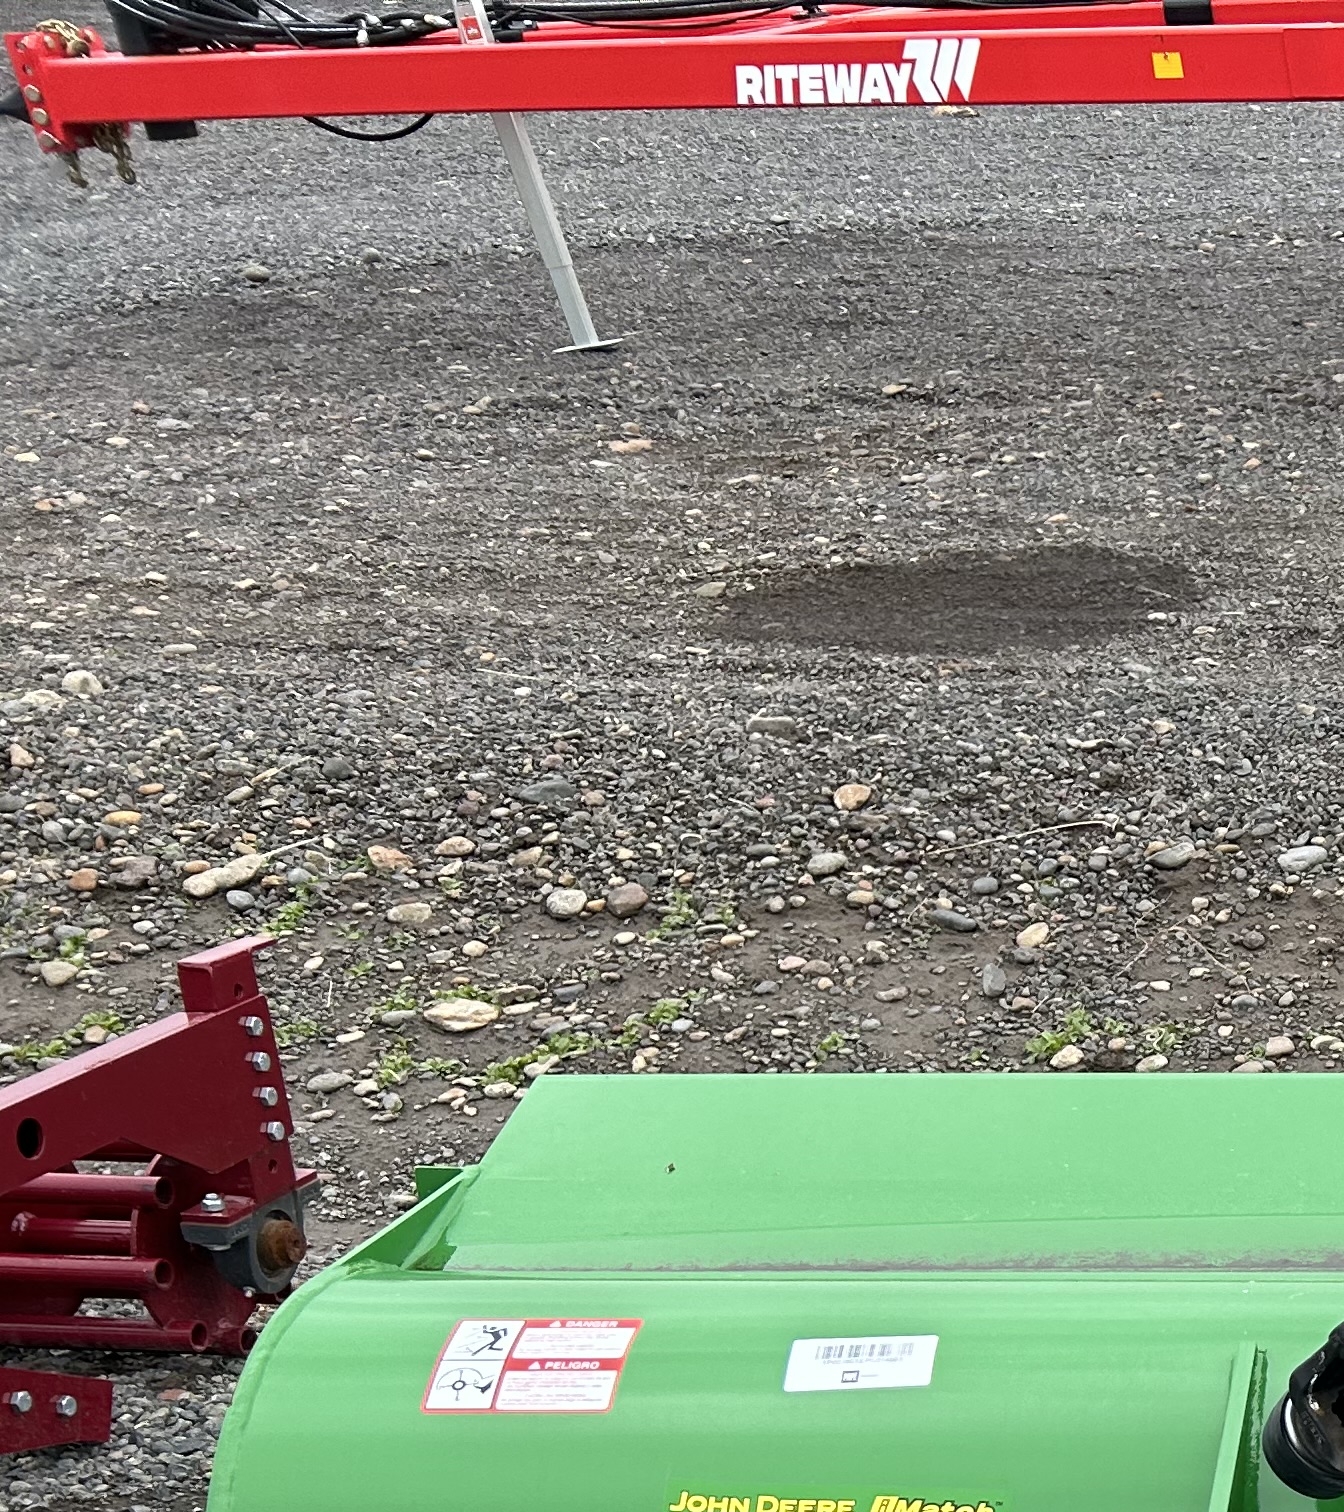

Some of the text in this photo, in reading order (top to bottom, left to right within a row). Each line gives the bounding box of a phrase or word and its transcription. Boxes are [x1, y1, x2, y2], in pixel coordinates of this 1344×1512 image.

[735, 62, 912, 105] RITEWAY
[565, 1320, 619, 1328] DANGER
[543, 1361, 601, 1370] PELIGRO
